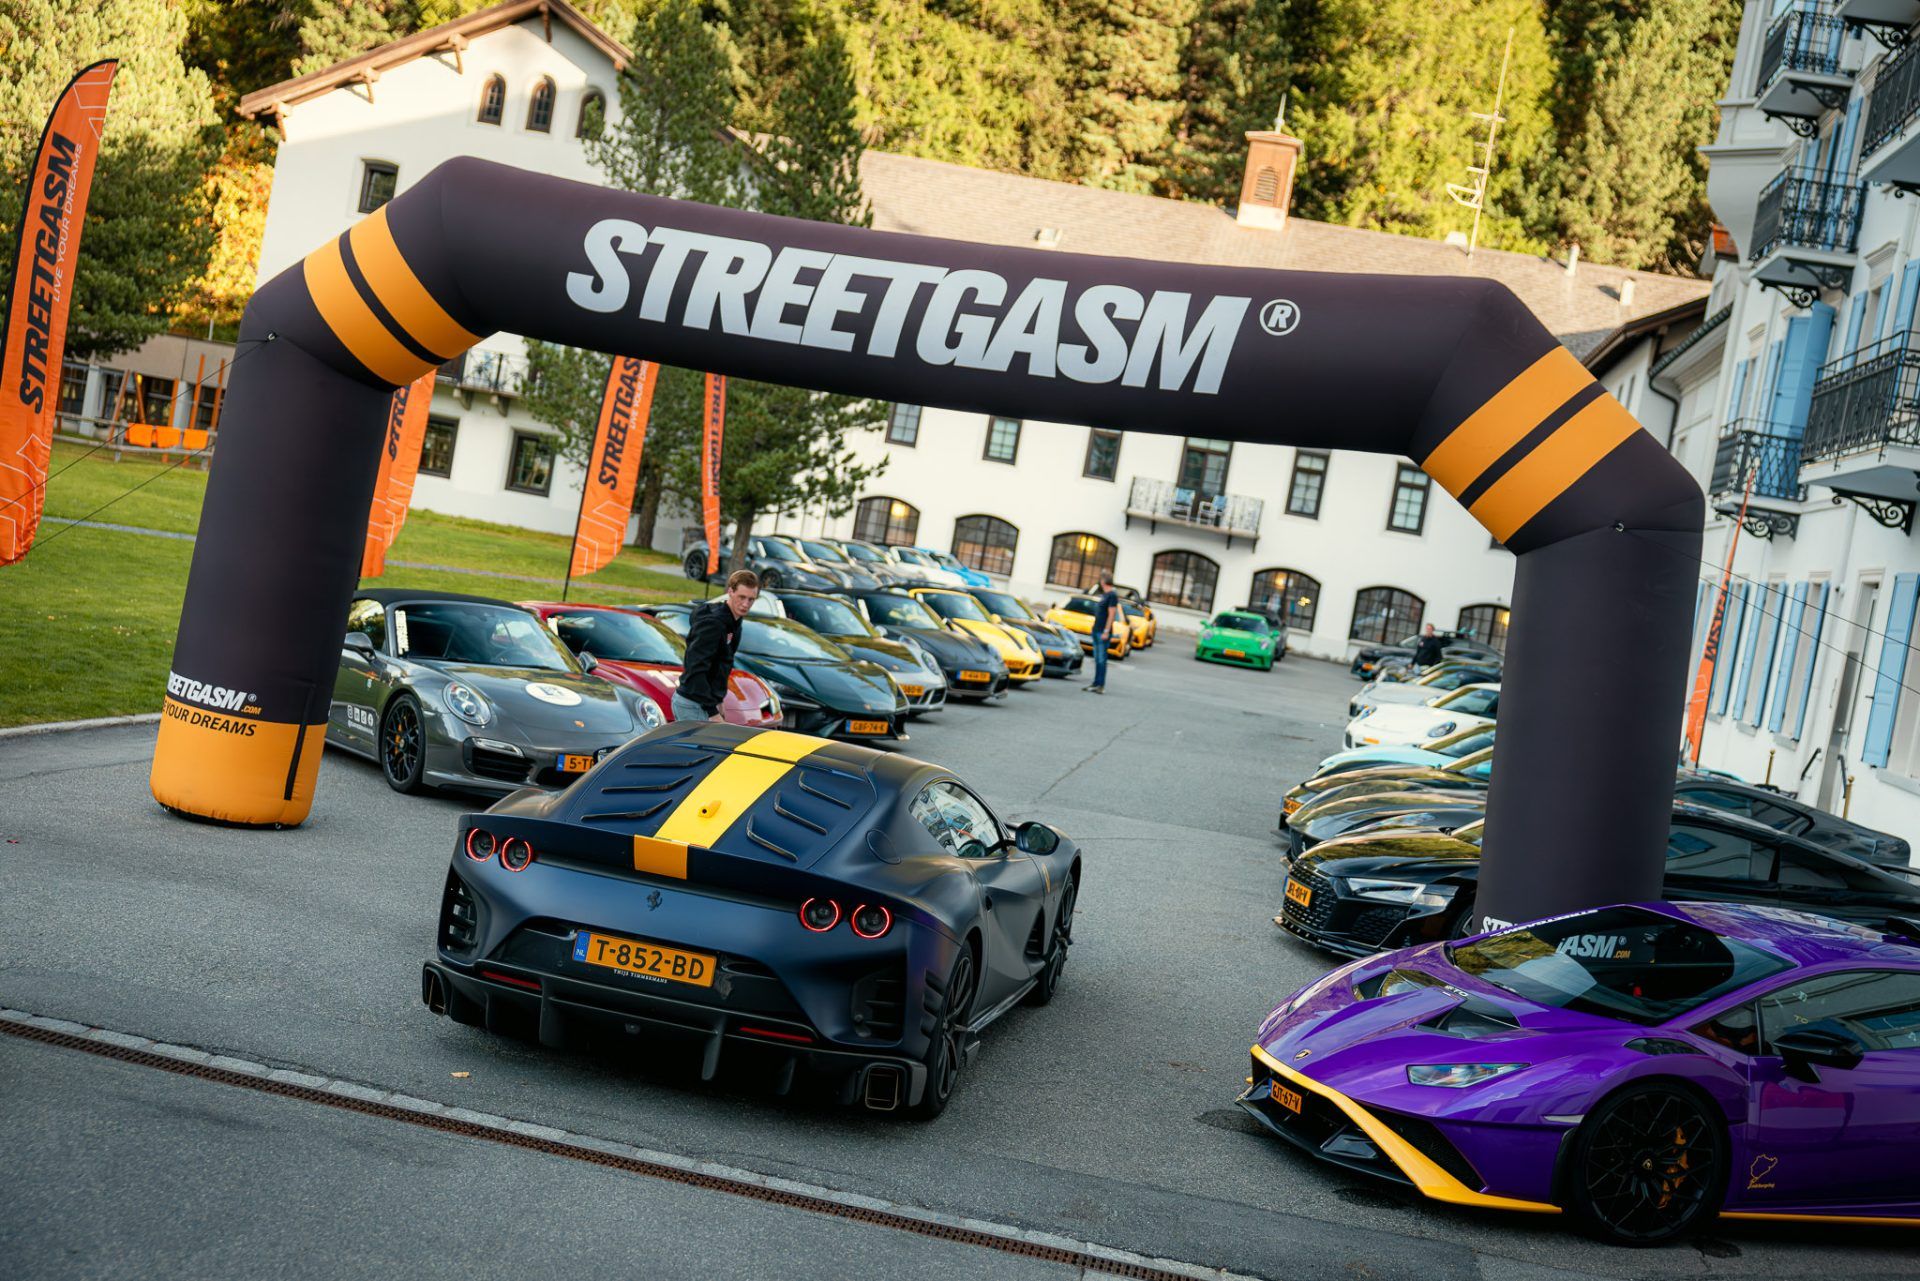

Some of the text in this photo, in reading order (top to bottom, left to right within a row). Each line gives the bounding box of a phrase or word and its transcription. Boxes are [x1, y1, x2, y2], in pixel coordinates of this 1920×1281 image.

[19, 131, 76, 416] STREETGASM
[52, 143, 83, 302] LIVE YOUR DREAMS
[566, 219, 1252, 395] STREETGASM
[190, 711, 258, 736] DREAMS
[596, 939, 704, 980] T-852-BD
